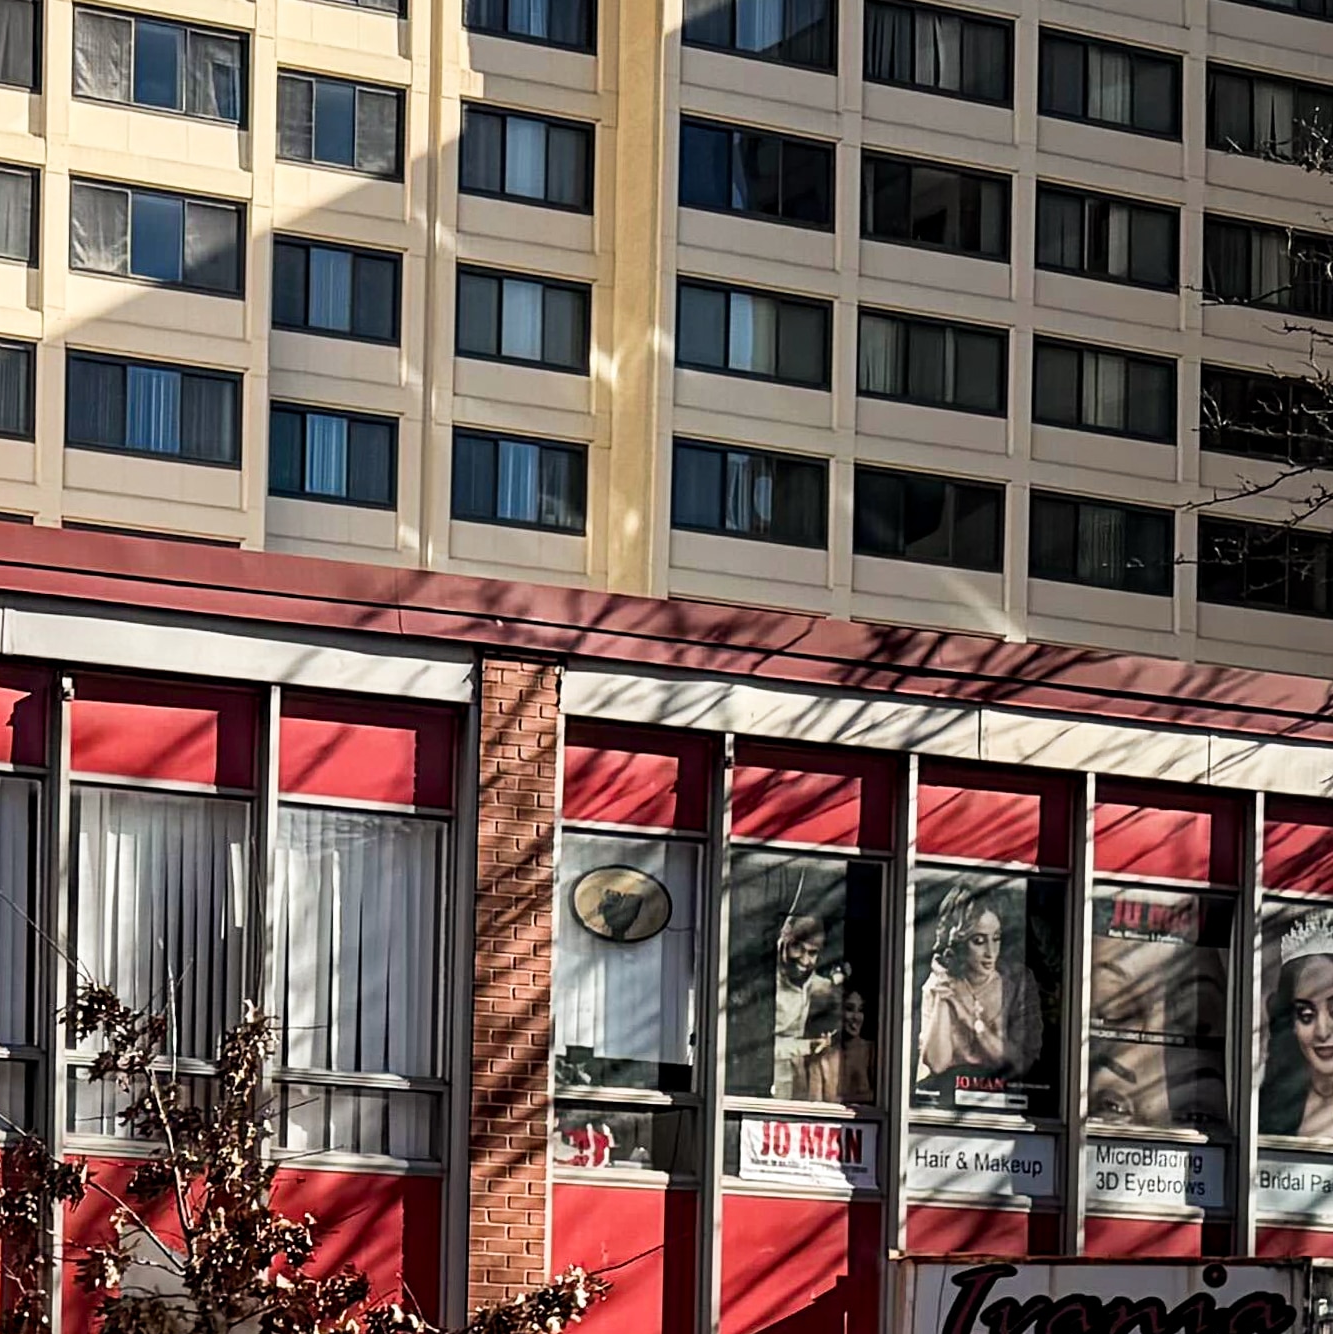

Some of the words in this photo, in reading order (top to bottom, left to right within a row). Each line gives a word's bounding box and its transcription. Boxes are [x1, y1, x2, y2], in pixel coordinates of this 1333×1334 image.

[760, 1120, 791, 1158] JO
[799, 1125, 863, 1164] MAN
[914, 1147, 952, 1169] Hair
[955, 1153, 969, 1171] &
[973, 1153, 1043, 1178] Makeup
[1095, 1145, 1204, 1174] MicroBlading
[1095, 1173, 1119, 1191] 3D
[1125, 1174, 1206, 1197] Eyebrows
[1260, 1170, 1305, 1191] Bridal
[1311, 1173, 1333, 1193] Pa
